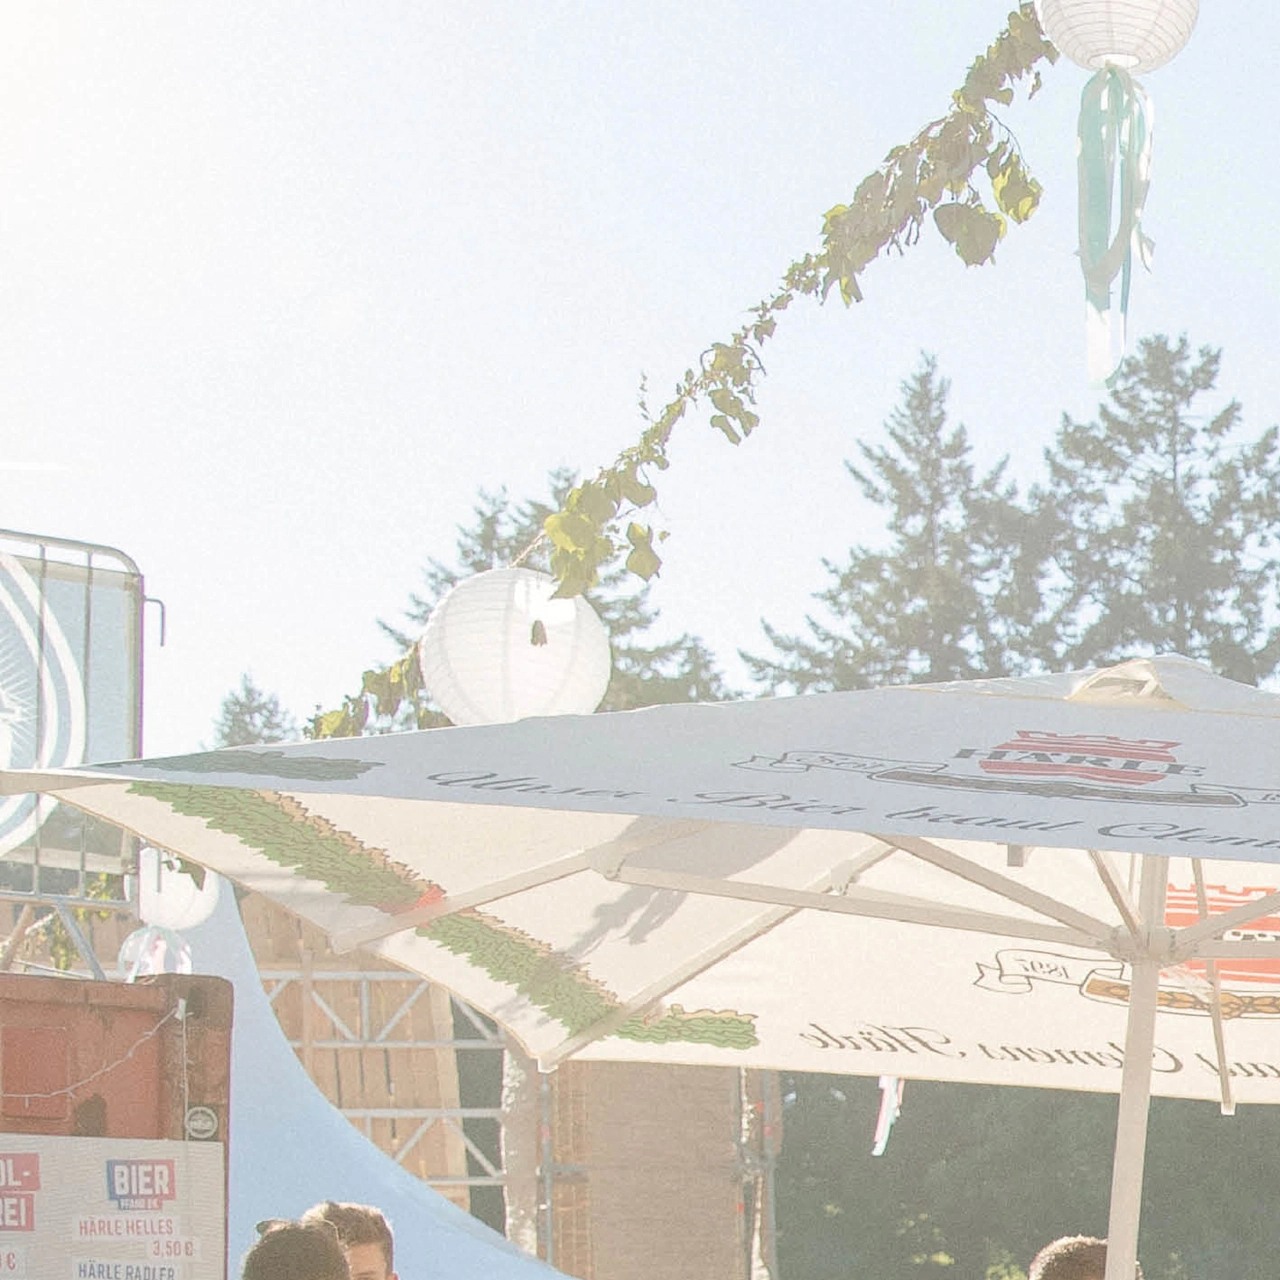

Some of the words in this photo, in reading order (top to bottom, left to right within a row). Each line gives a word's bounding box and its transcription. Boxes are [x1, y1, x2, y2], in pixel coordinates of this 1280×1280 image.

[953, 748, 1206, 779] HÄRLE
[426, 771, 650, 799] Unser
[667, 788, 866, 815] Bier
[113, 1164, 169, 1196] BIER
[79, 1215, 123, 1236] HÄRLE
[126, 1218, 174, 1236] HELLES
[78, 1259, 122, 1280] HÄRLE
